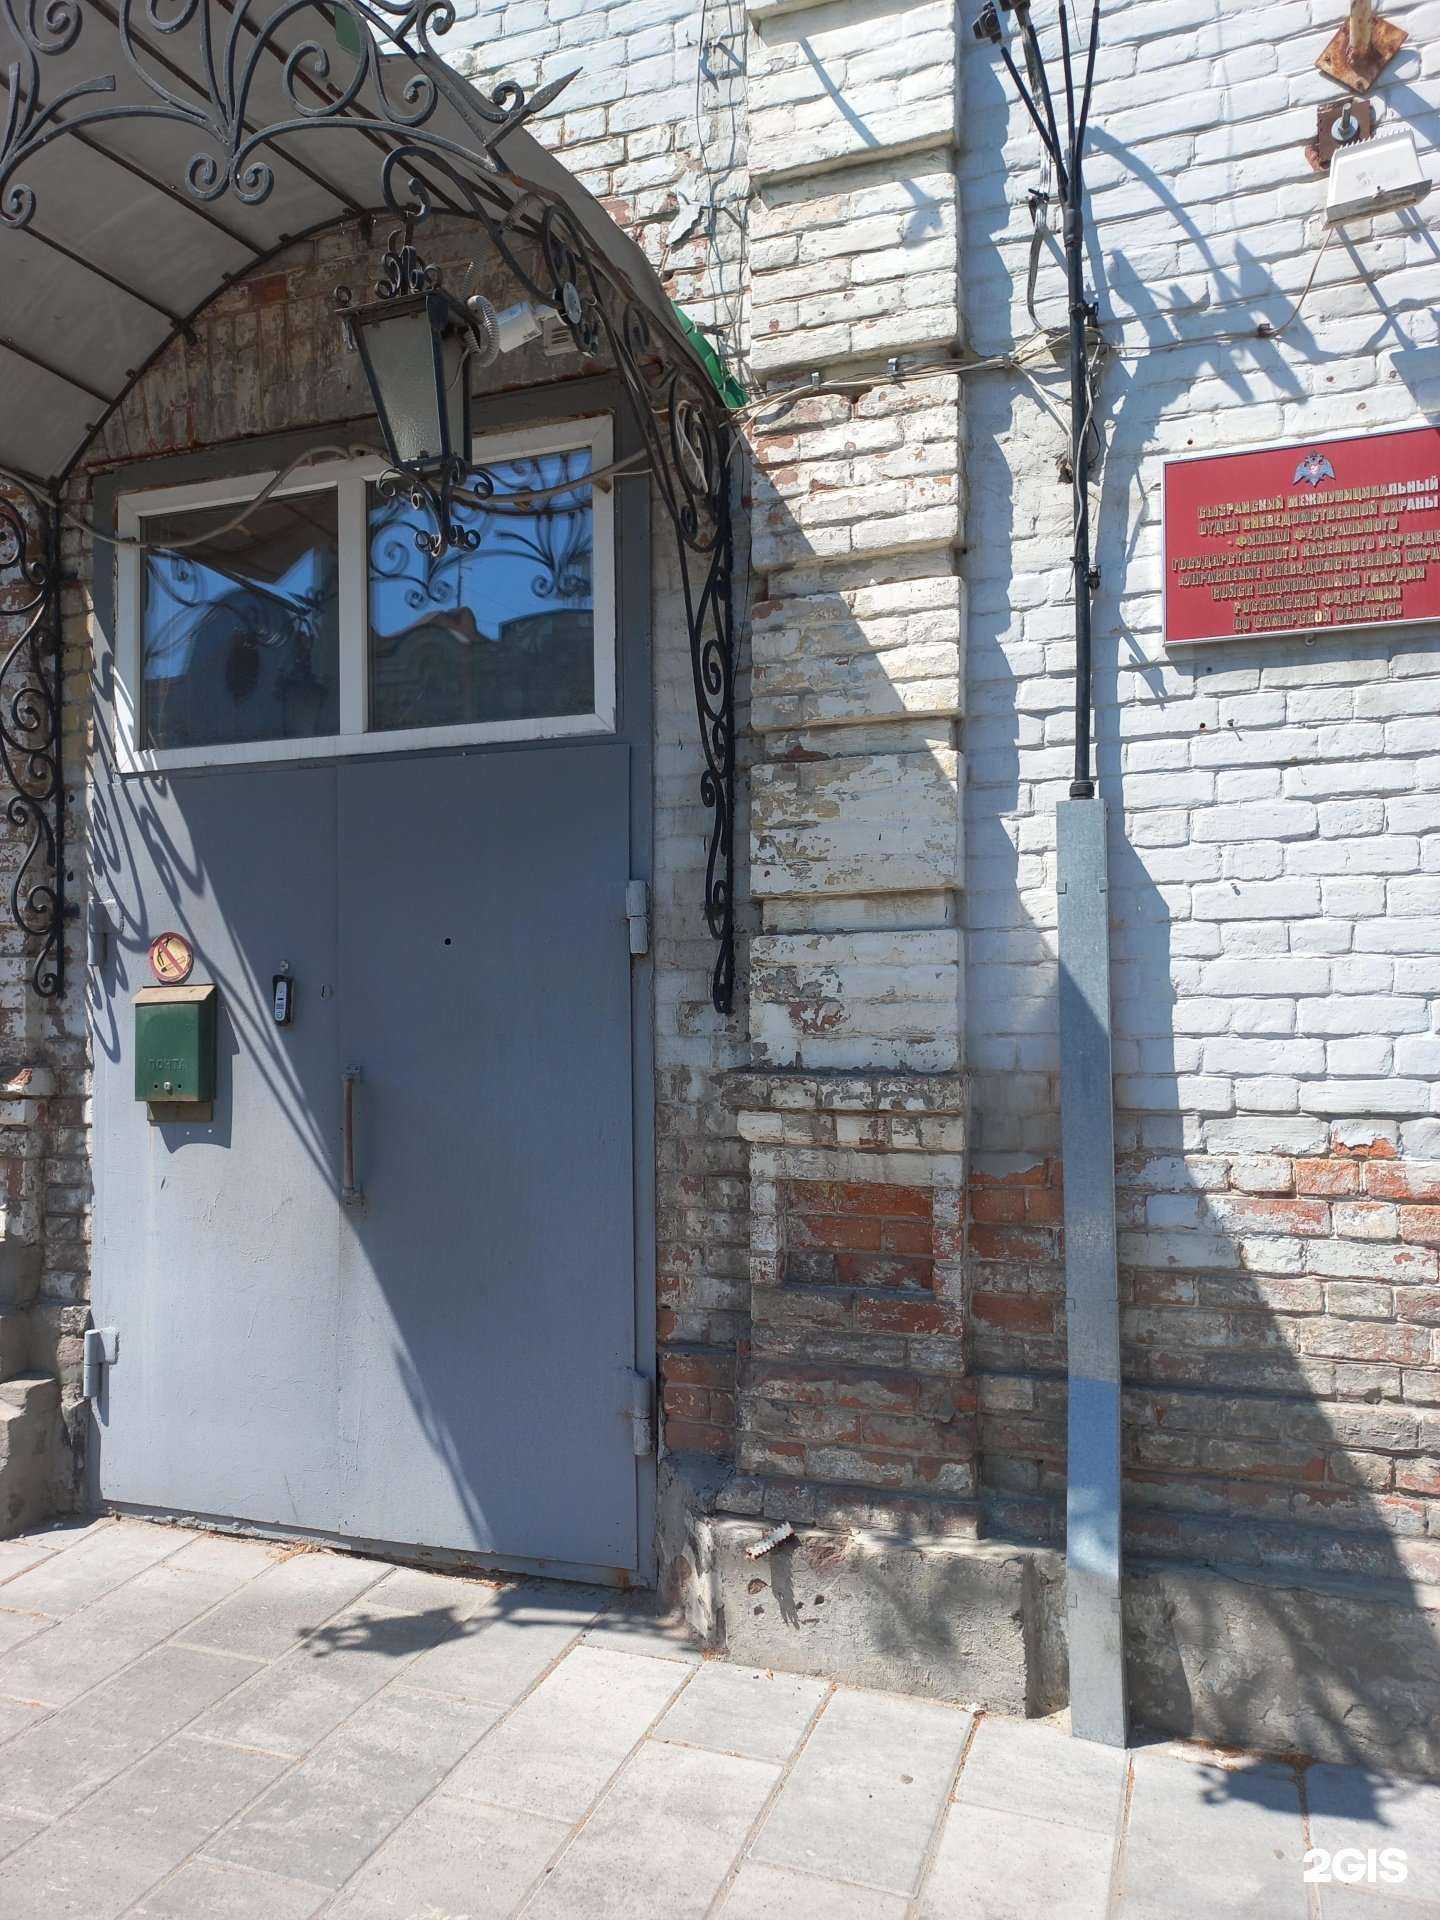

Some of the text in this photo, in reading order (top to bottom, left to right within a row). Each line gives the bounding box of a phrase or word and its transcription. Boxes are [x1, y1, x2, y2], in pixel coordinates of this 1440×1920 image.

[1287, 475, 1439, 508] МЕЖМУНИЦИПАЛЬНЫЙ
[1199, 520, 1239, 535] ОТДЕЛ
[1383, 496, 1438, 514] ОХРАНЫ
[1236, 529, 1290, 546] ФИЛИАЛ
[1294, 516, 1398, 540] ФЕДЕРАЛЬНОГО
[1212, 583, 1254, 599] ВОЙСК
[1364, 566, 1425, 584] ГВАРДИИ
[1322, 585, 1401, 605] ФЕДЕРАЦИИ
